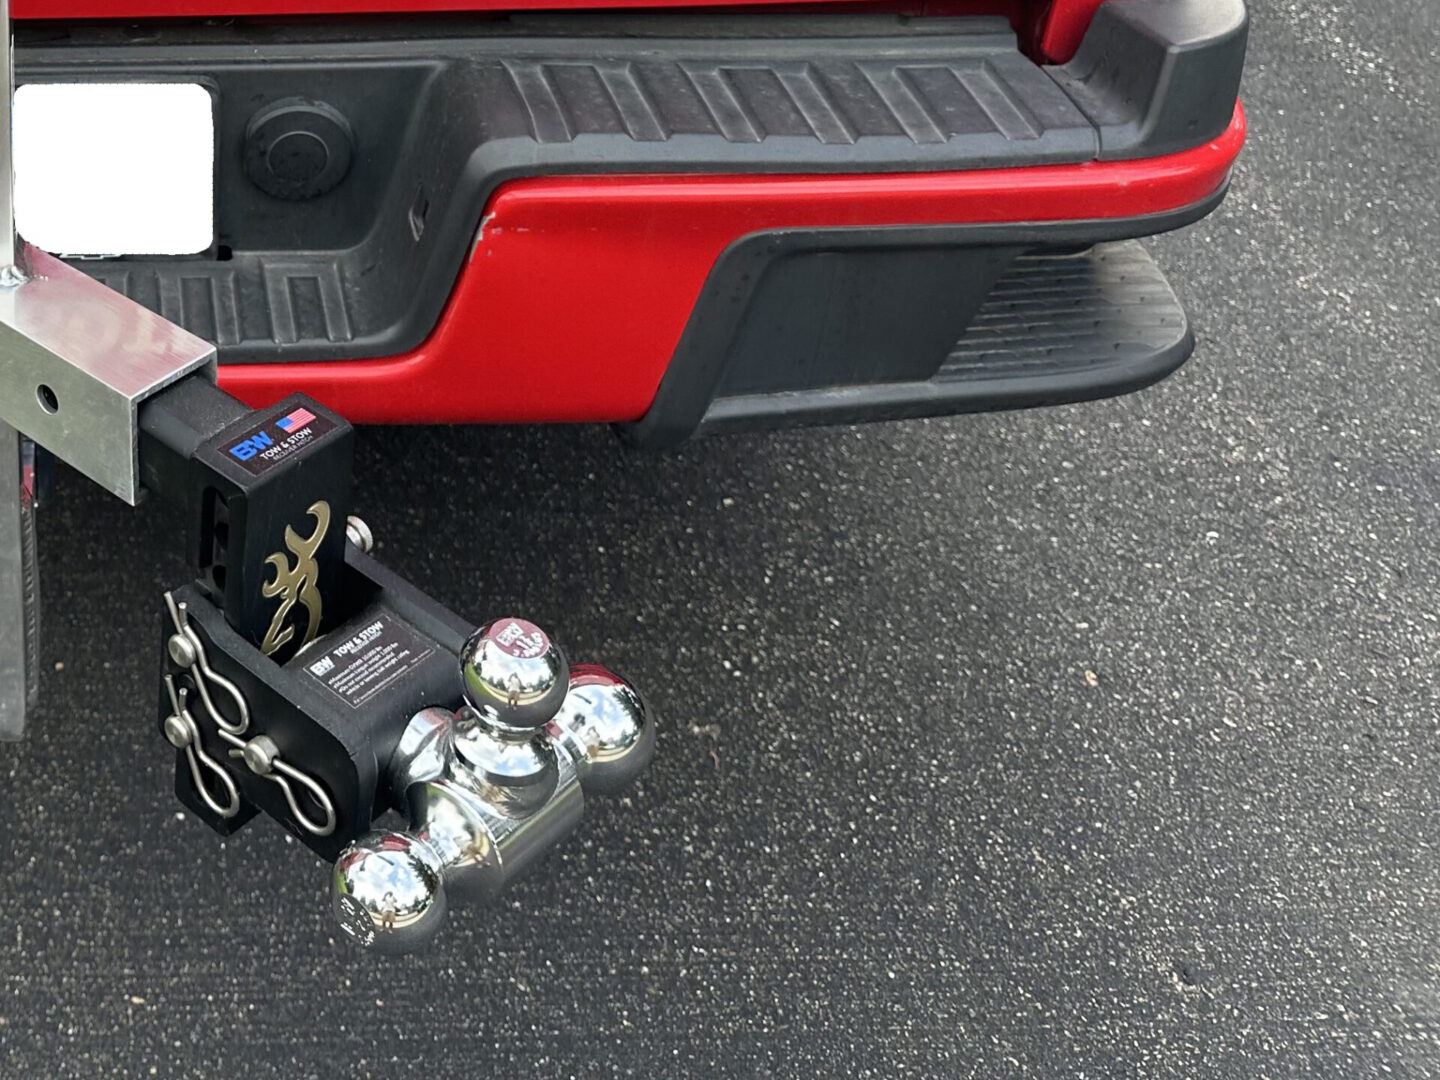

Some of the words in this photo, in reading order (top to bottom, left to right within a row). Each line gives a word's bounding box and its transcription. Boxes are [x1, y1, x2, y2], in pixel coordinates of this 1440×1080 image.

[260, 445, 281, 460] TOW
[286, 427, 312, 444] STOW
[332, 641, 356, 657] TOW
[351, 636, 362, 644] &
[358, 621, 385, 639] STOW
